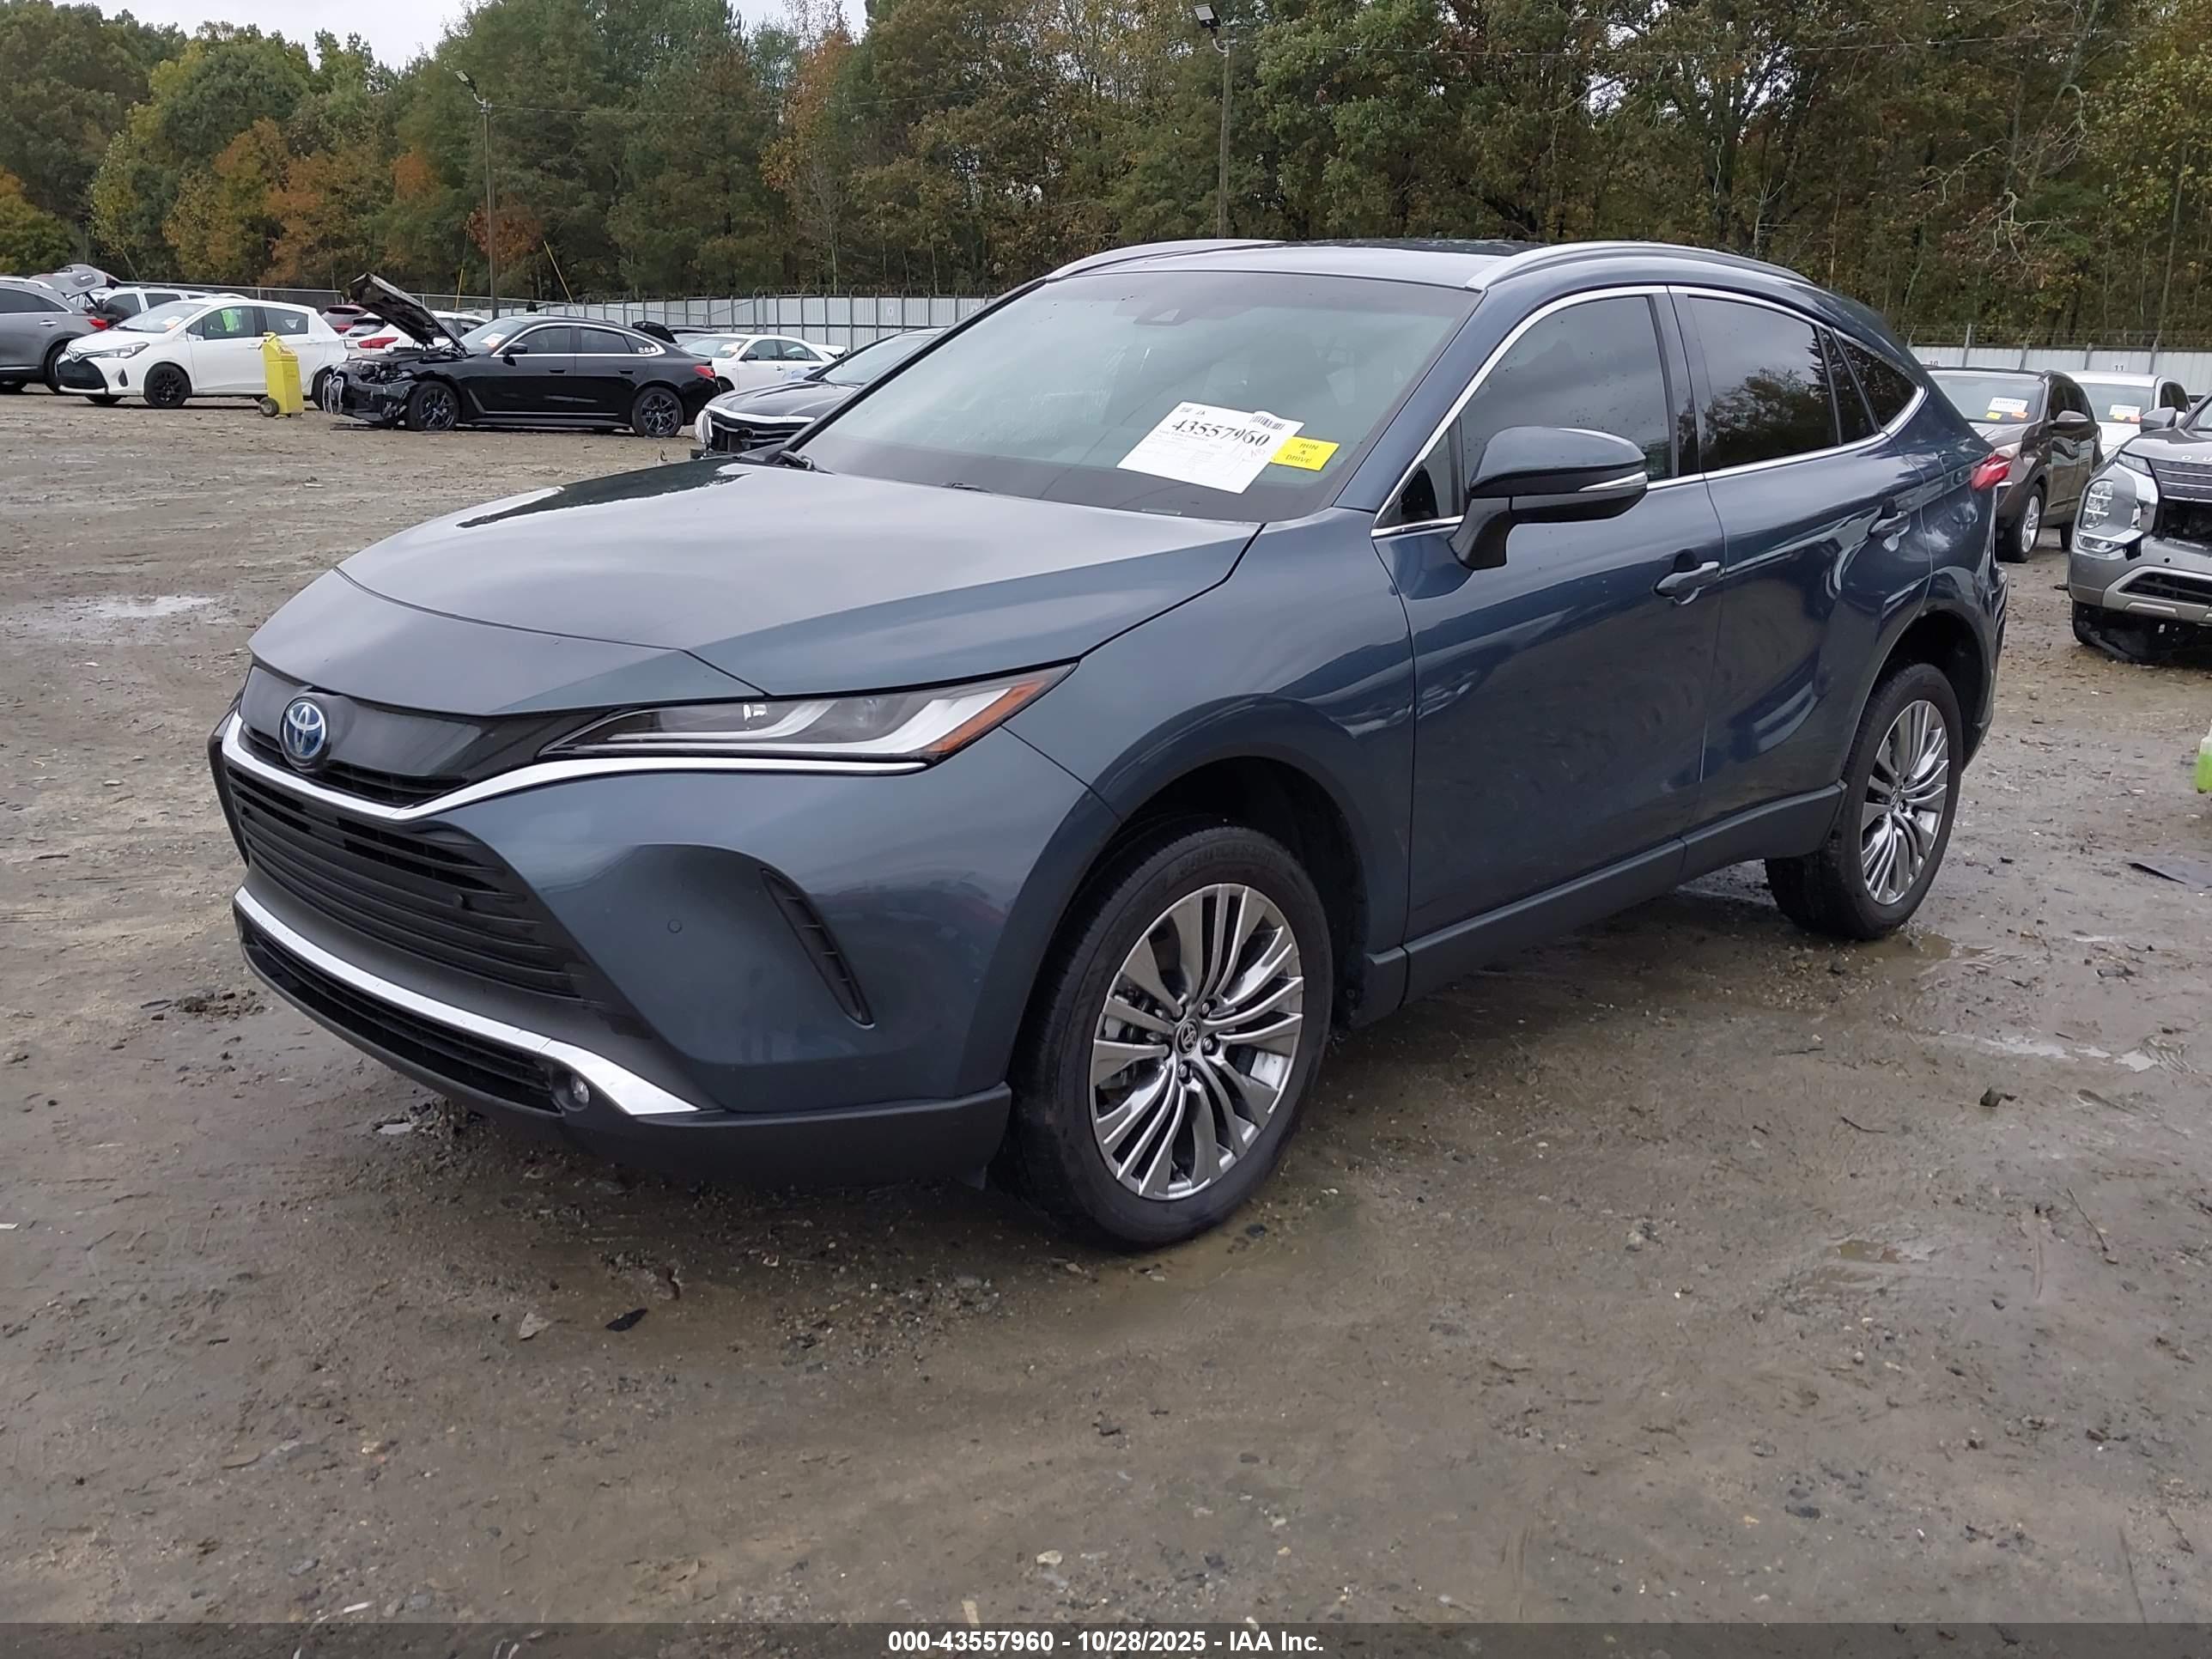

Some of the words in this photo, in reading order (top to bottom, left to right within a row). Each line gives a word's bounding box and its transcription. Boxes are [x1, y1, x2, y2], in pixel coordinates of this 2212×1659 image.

[1171, 419, 1271, 447] 43557960
[1299, 442, 1319, 451] RUN
[1285, 453, 1312, 464] DRIVE
